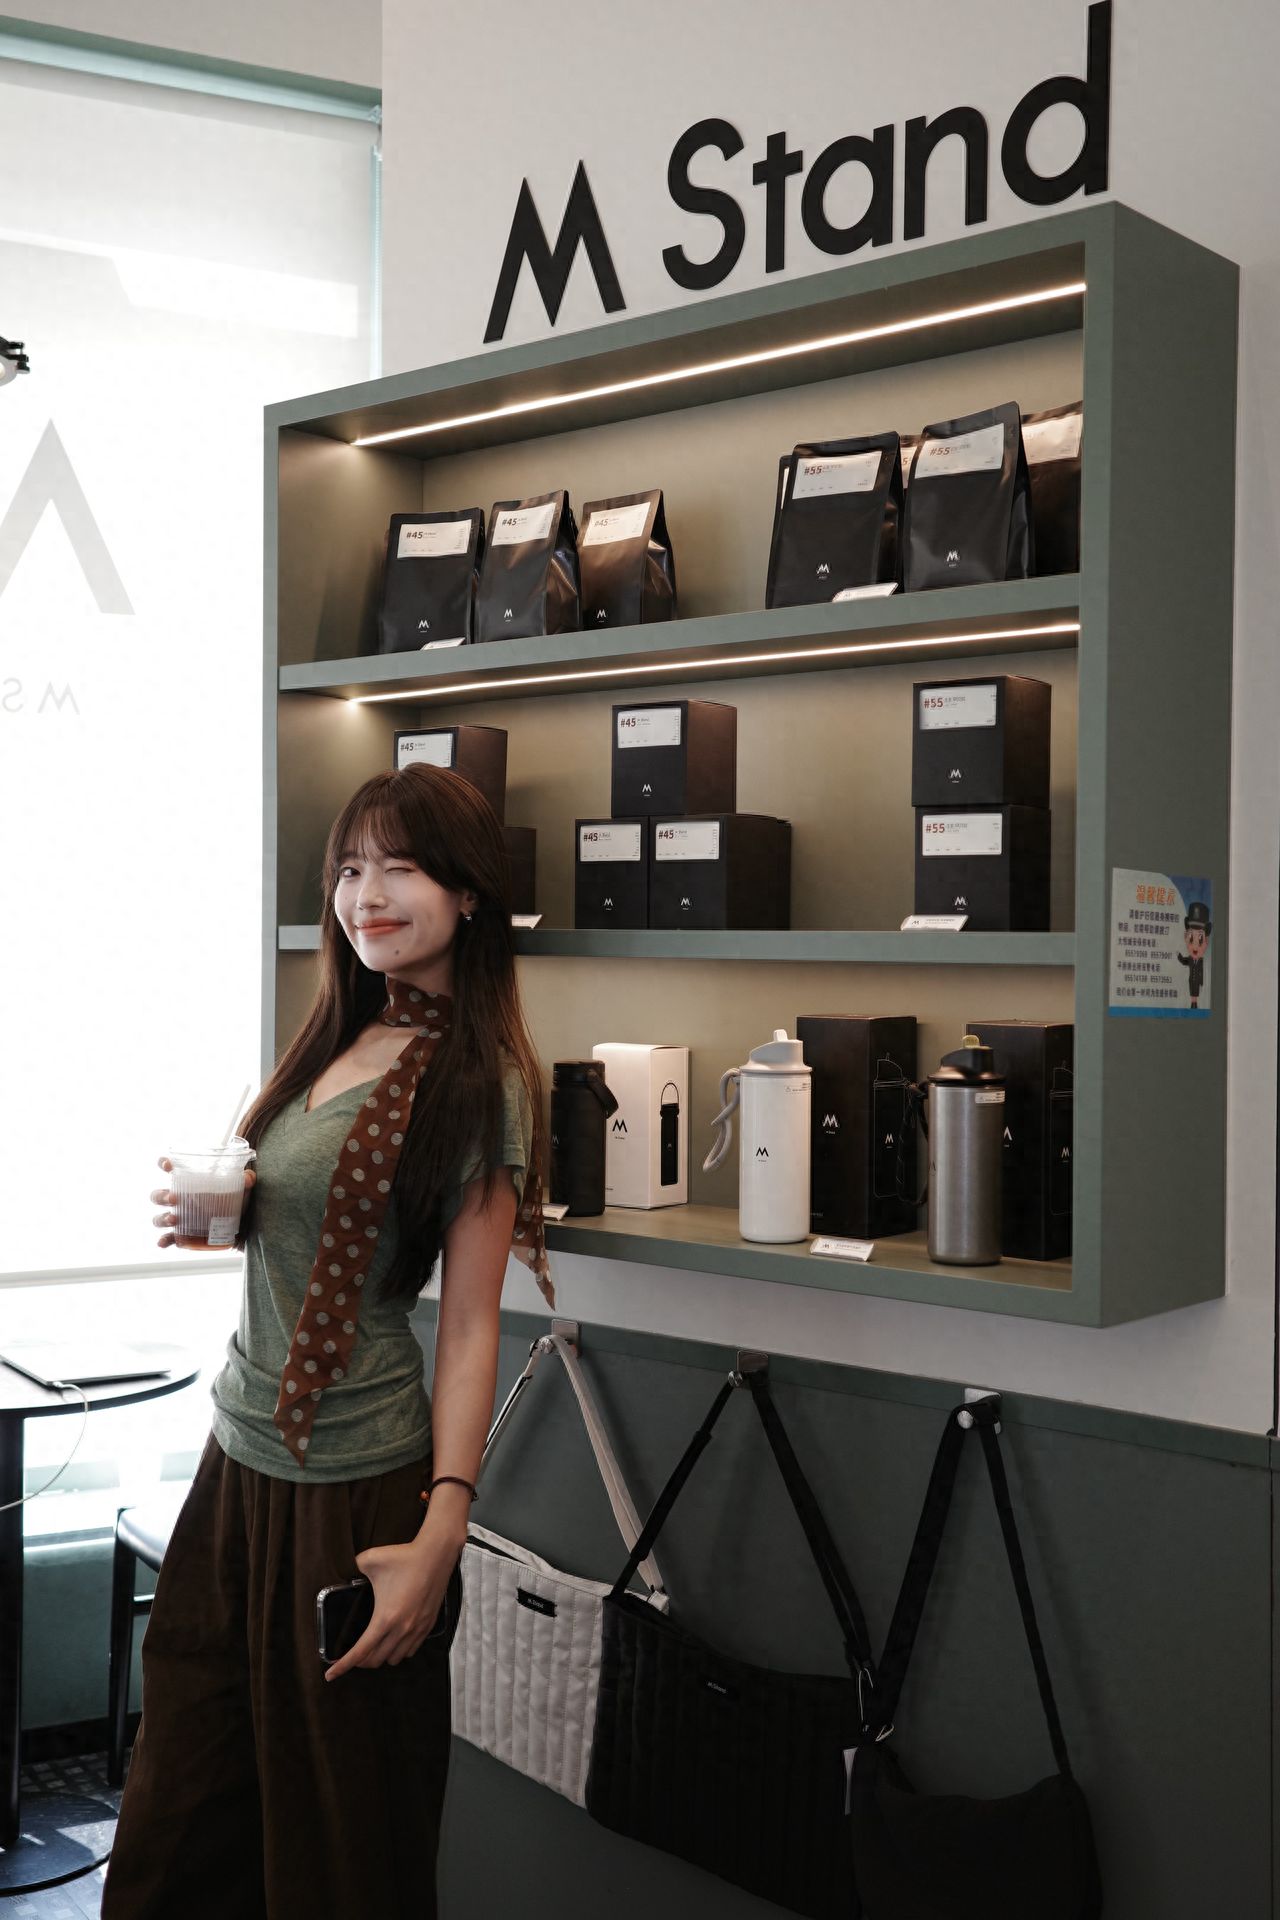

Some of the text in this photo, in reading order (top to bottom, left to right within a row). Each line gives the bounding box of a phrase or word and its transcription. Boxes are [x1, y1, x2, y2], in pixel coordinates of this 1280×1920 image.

[484, 1, 1112, 344] M Stand
[930, 446, 951, 457] #55
[803, 465, 823, 475] #55
[501, 518, 518, 527] #45
[594, 518, 609, 527] #45
[406, 531, 424, 539] #45
[503, 608, 514, 618] M
[596, 608, 607, 619] M
[418, 619, 430, 629] M
[923, 697, 944, 709] #55
[620, 717, 637, 728] #45
[400, 742, 414, 752] #45
[950, 768, 962, 779] M
[641, 783, 653, 793] M
[925, 823, 945, 834] #55
[583, 832, 599, 842] #45
[658, 829, 674, 840] #45
[603, 897, 614, 907] M
[680, 897, 692, 907] M
[954, 896, 966, 907] M
[612, 1118, 628, 1133] M
[822, 1112, 839, 1128] M
[755, 1146, 769, 1157] M
